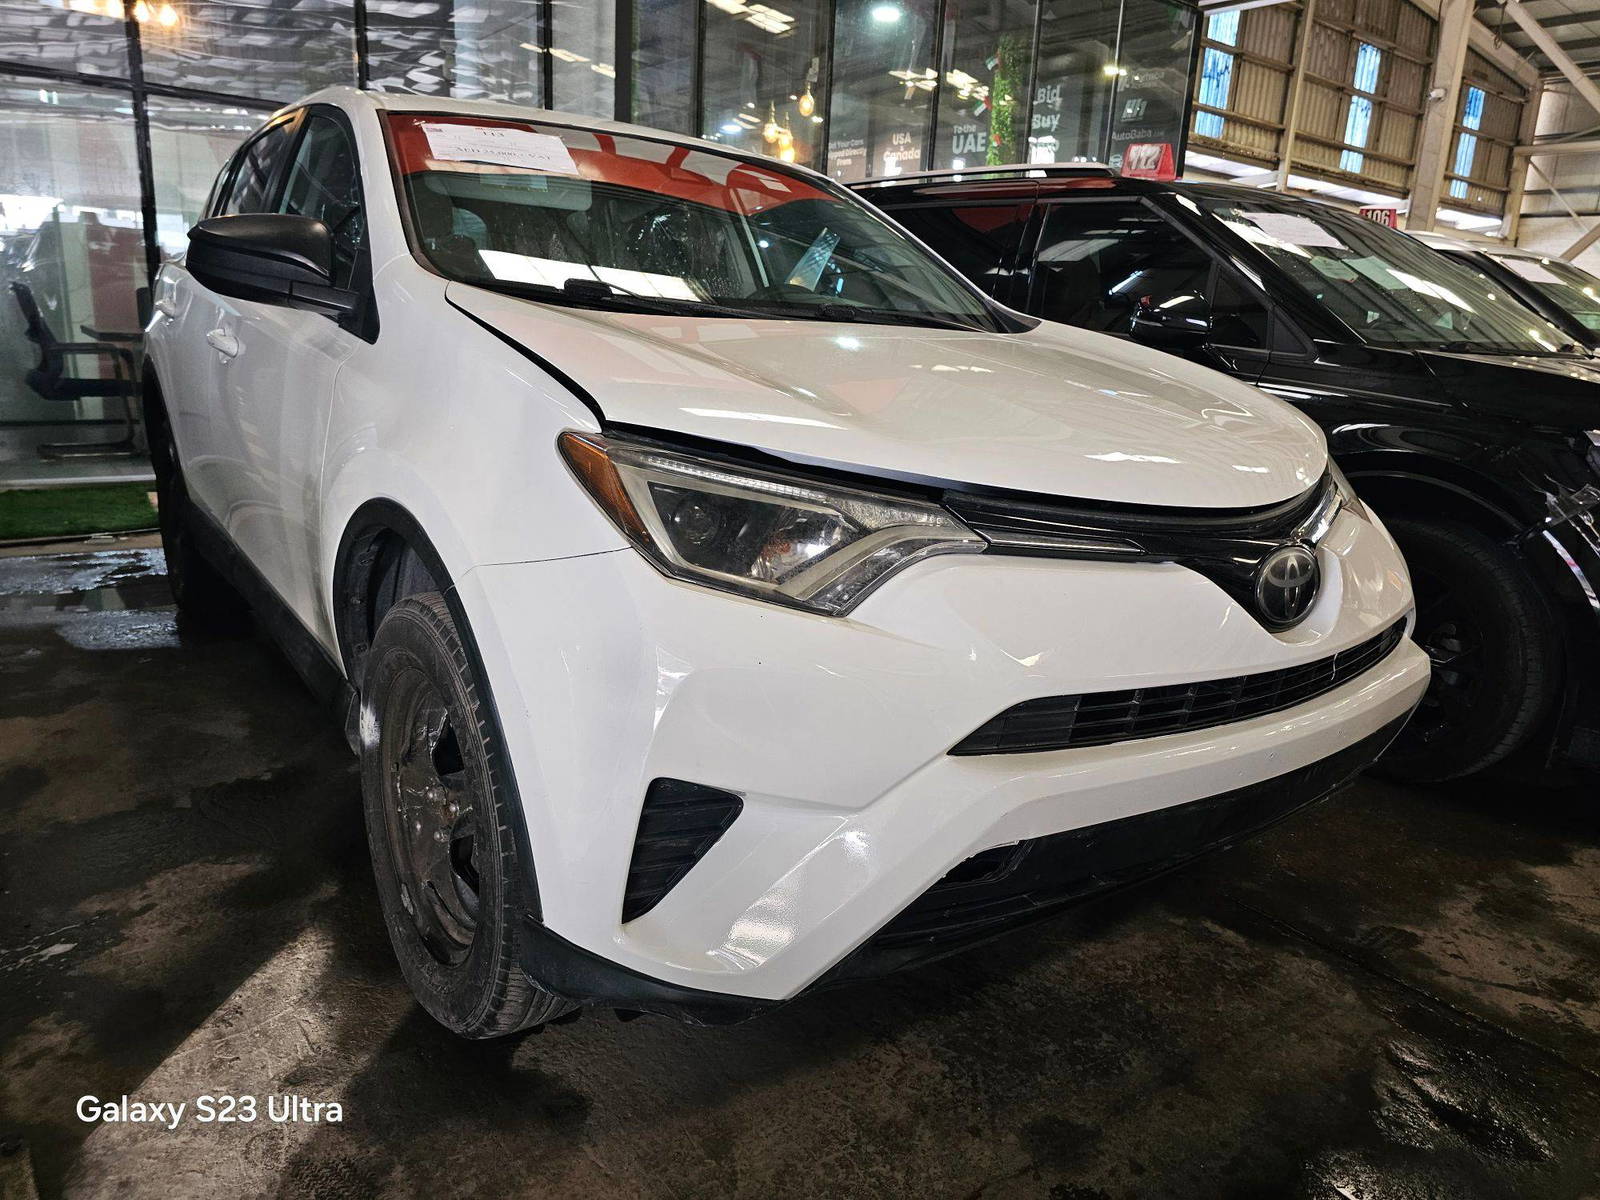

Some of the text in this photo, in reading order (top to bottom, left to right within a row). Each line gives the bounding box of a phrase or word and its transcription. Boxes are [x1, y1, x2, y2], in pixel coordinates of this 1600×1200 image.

[1032, 114, 1060, 131] Buy
[892, 133, 912, 145] USA
[952, 132, 987, 154] UAE
[883, 146, 921, 160] Canada
